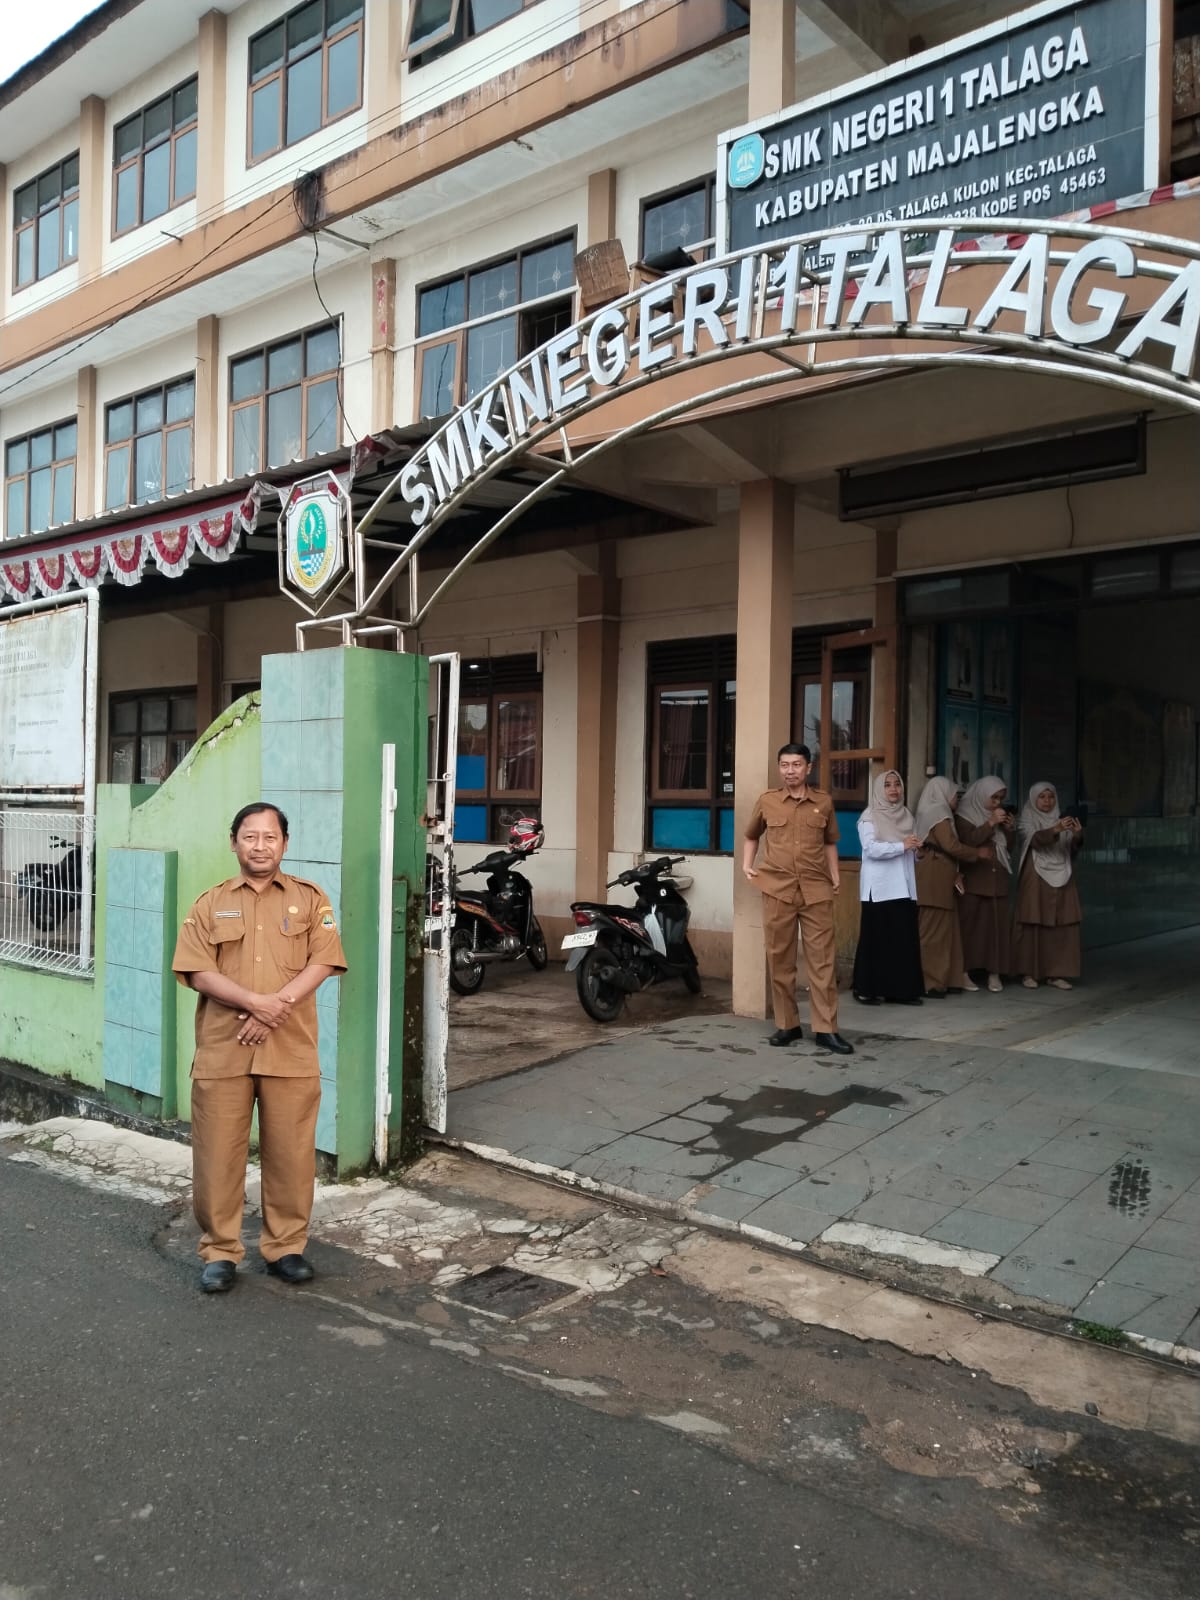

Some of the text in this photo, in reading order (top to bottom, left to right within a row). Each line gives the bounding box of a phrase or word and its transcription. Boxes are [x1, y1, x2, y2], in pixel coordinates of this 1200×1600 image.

[755, 85, 1104, 228] KABUPATEN MAJALENGKA
[765, 26, 1088, 178] SMK NEGERI 1 TALAGA
[898, 192, 948, 220] TALAGA
[953, 175, 999, 203] KULON
[981, 194, 1017, 218] KODE
[1023, 184, 1051, 206] POS
[1059, 167, 1106, 194] 45463
[400, 228, 1200, 527] SMK NEGERI 1 TALAGA
